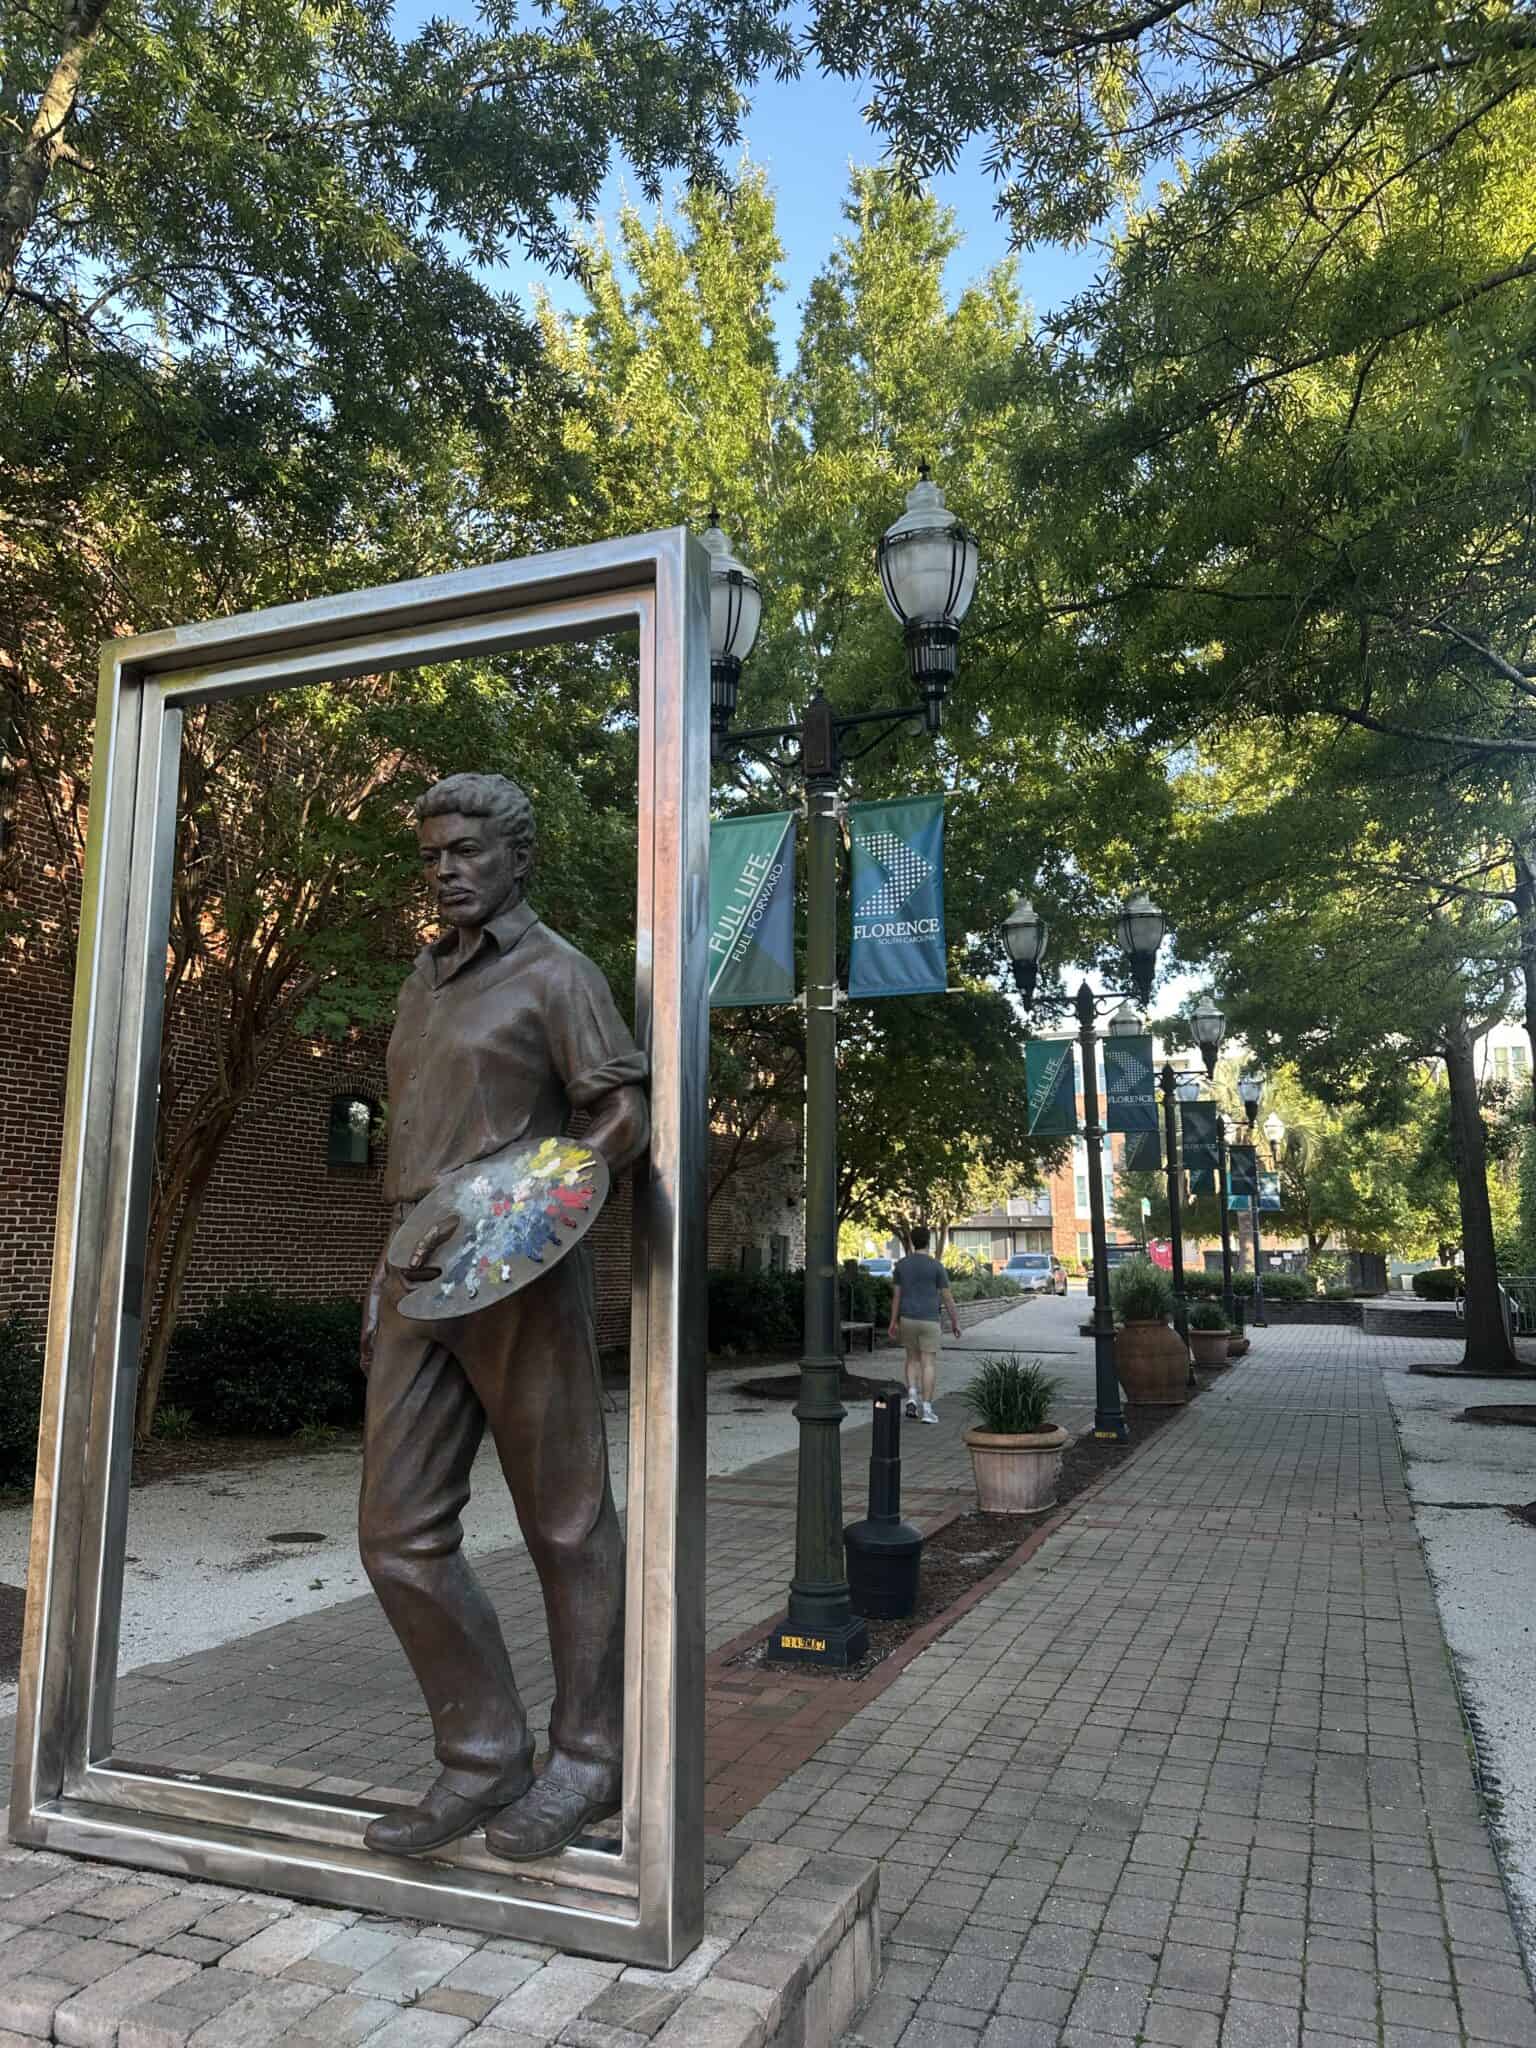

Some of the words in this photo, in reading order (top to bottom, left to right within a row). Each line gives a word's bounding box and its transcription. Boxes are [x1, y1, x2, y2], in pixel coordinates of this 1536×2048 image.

[708, 904, 747, 955] FULL
[734, 852, 771, 899] LIFE.
[853, 918, 941, 941] FLORENCE
[731, 931, 755, 963] FULL
[1029, 1082, 1049, 1109] FULL
